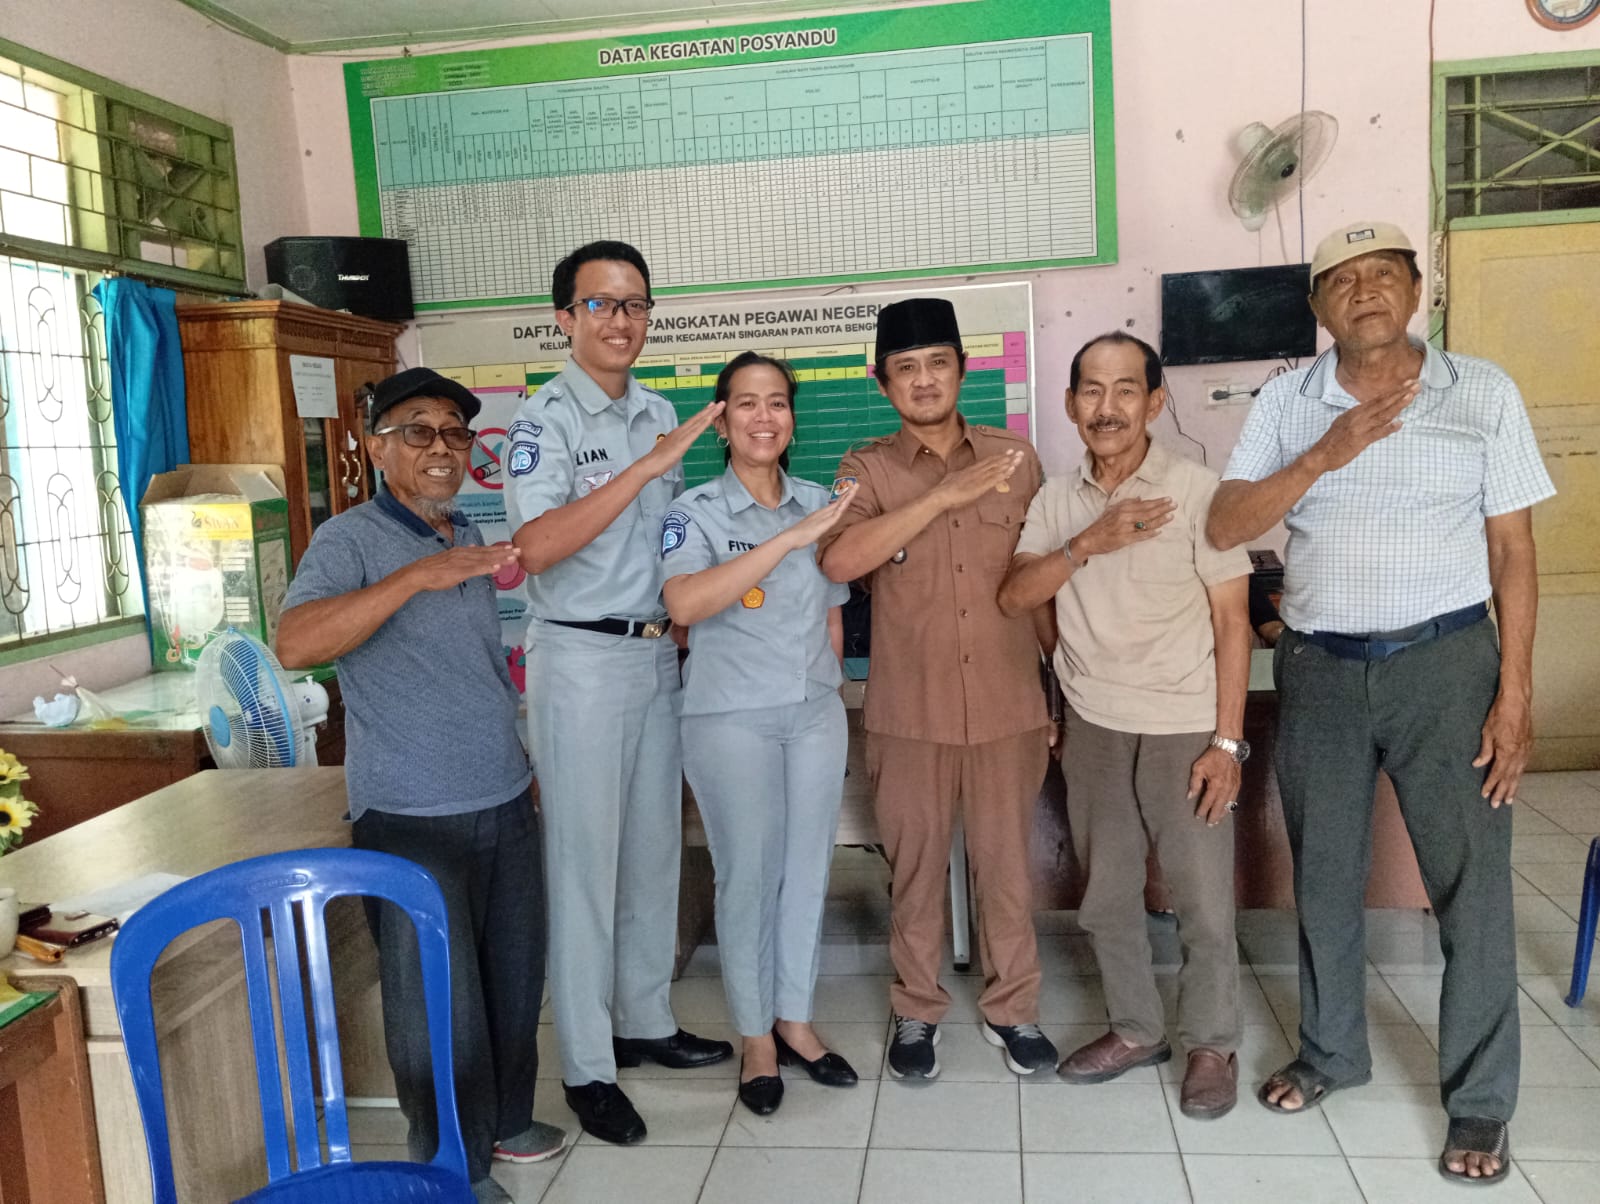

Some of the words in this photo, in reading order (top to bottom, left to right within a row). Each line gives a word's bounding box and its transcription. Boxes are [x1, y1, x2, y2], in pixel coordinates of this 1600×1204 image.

[599, 48, 645, 65] DATA
[650, 38, 735, 60] KEGIATAN
[740, 28, 837, 53] POSYANDU
[513, 324, 567, 339] DAFTA
[744, 308, 818, 325] PEGAWAI
[676, 331, 736, 343] KECAMATAN
[738, 327, 789, 339] SINGARAN
[791, 326, 813, 336] PATI
[815, 324, 842, 335] KOTA
[576, 448, 609, 466] LIAN
